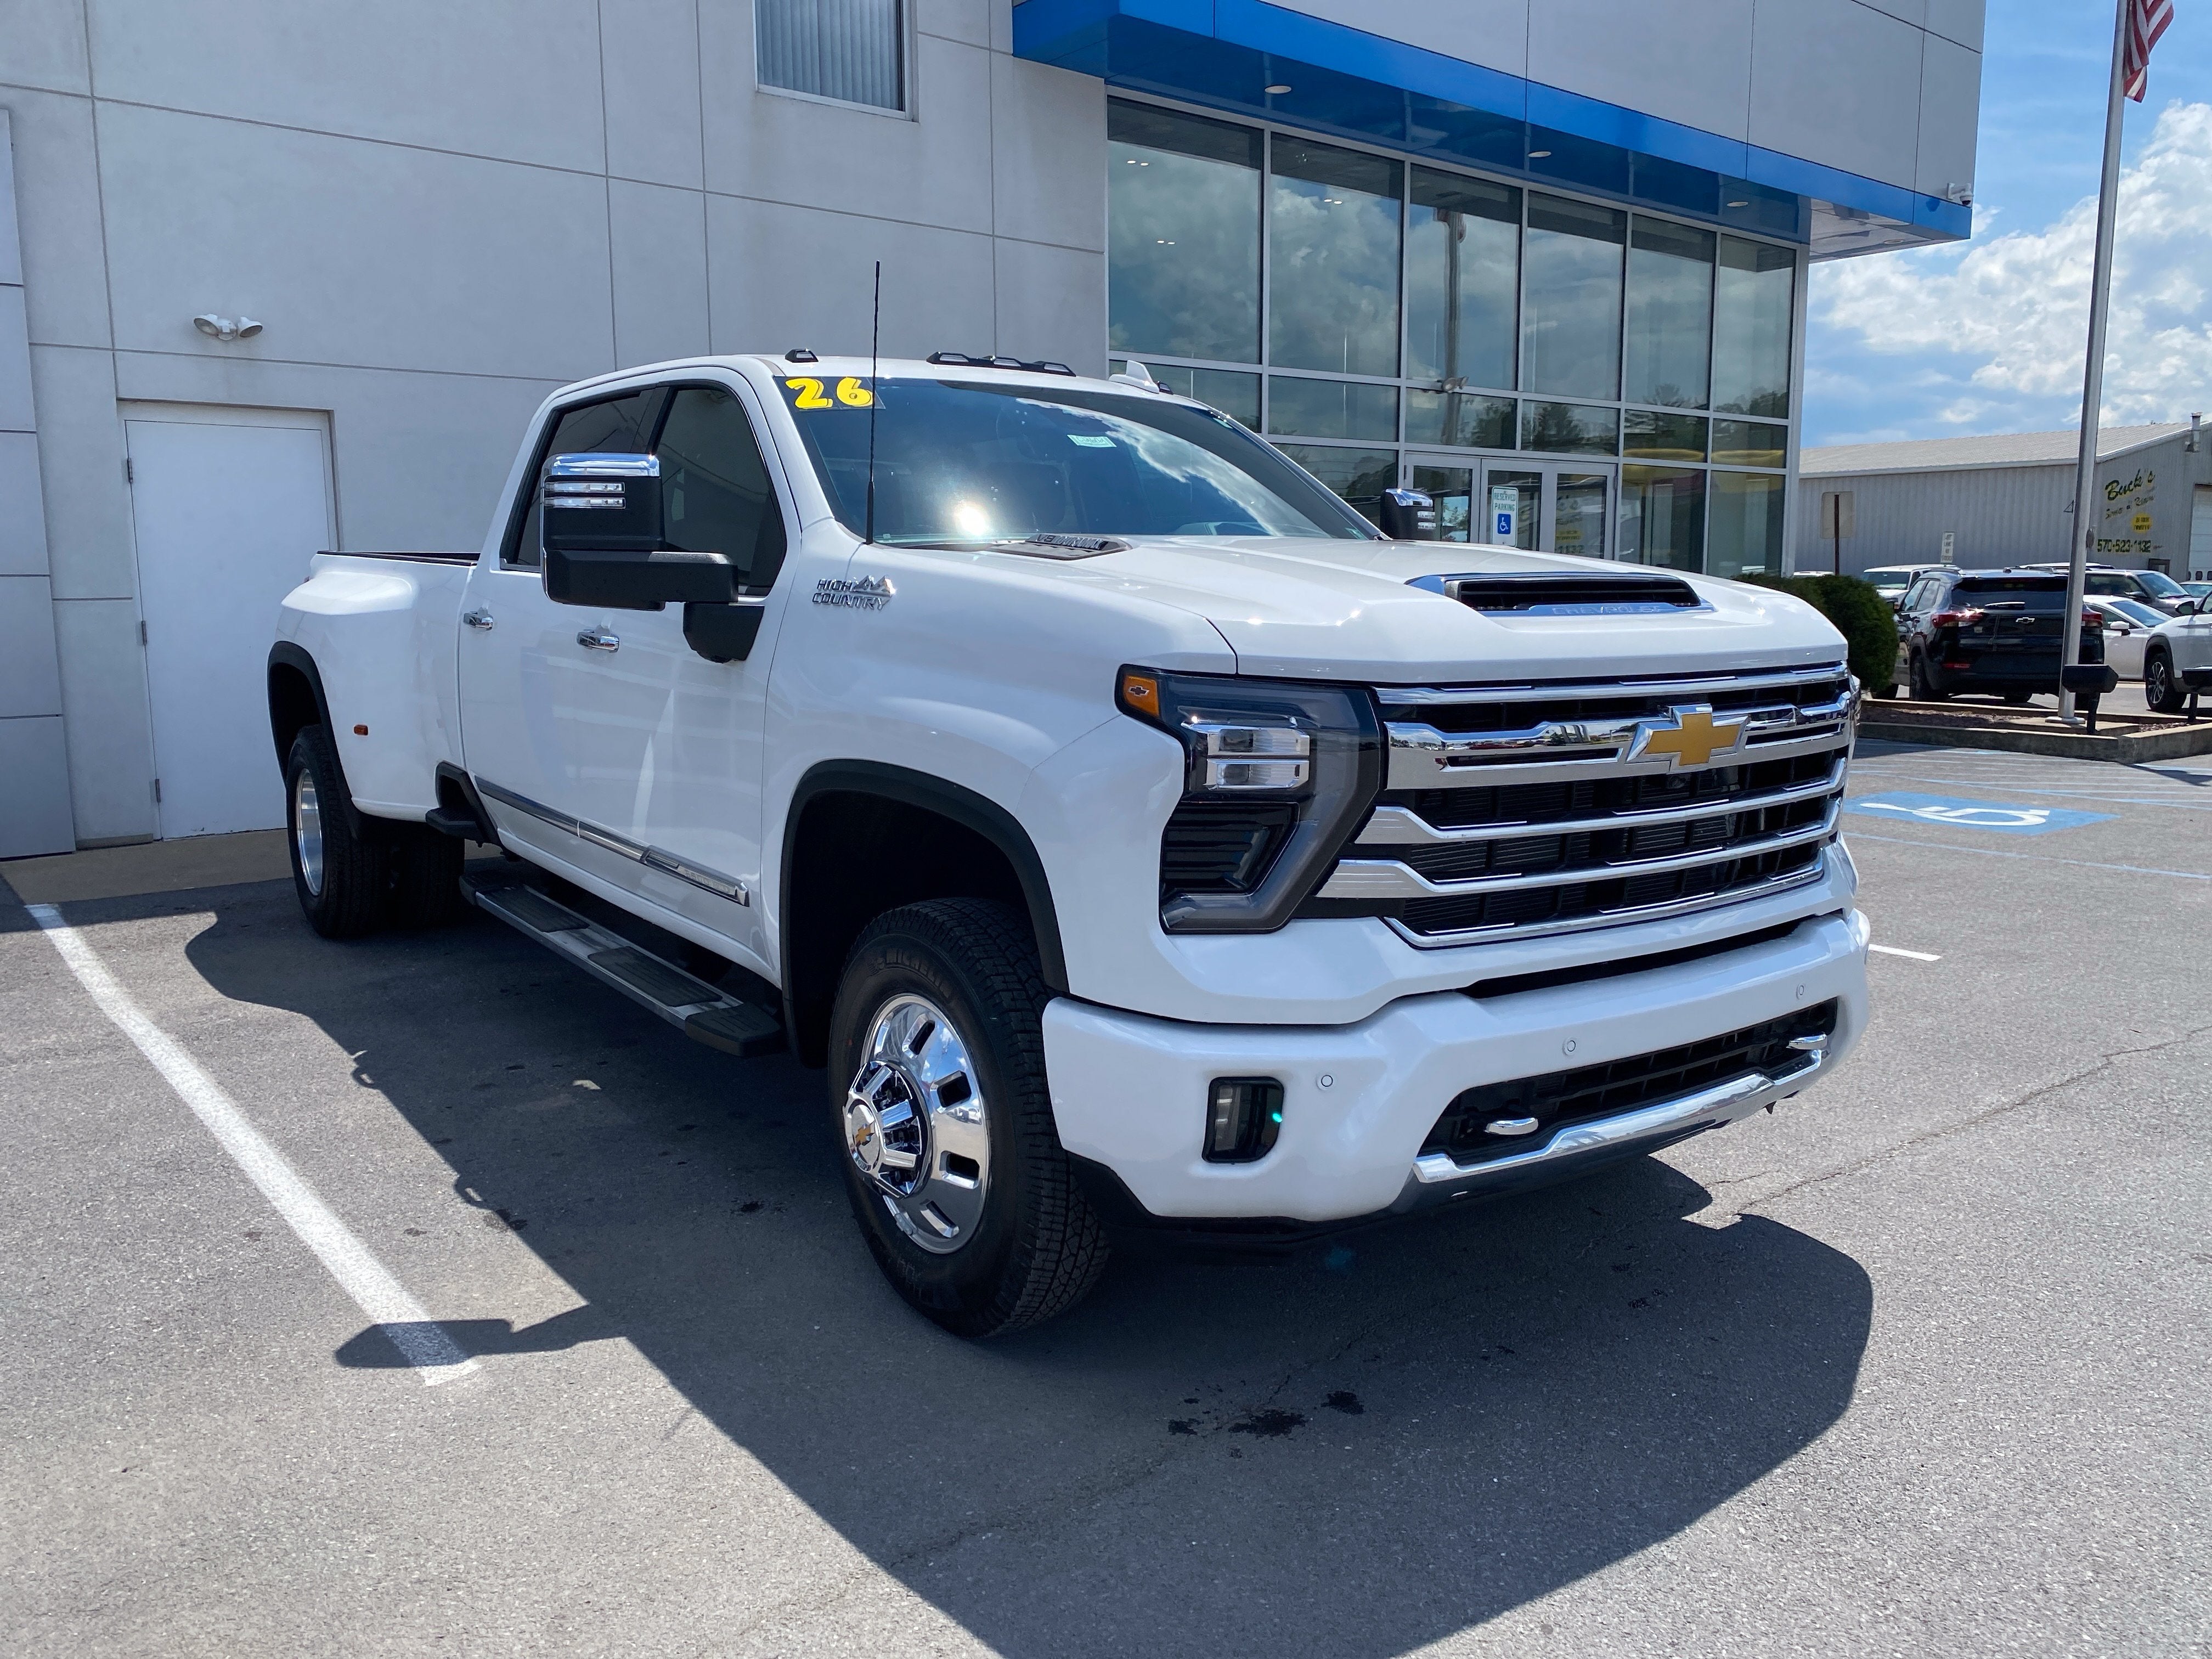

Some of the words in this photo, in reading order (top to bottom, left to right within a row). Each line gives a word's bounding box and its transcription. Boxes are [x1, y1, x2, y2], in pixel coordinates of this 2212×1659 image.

[785, 377, 873, 409] 26
[1494, 492, 1516, 501] RESERVED
[1494, 503, 1515, 512] PARKING
[816, 578, 853, 592] HIGH
[812, 592, 891, 611] COUNTRY
